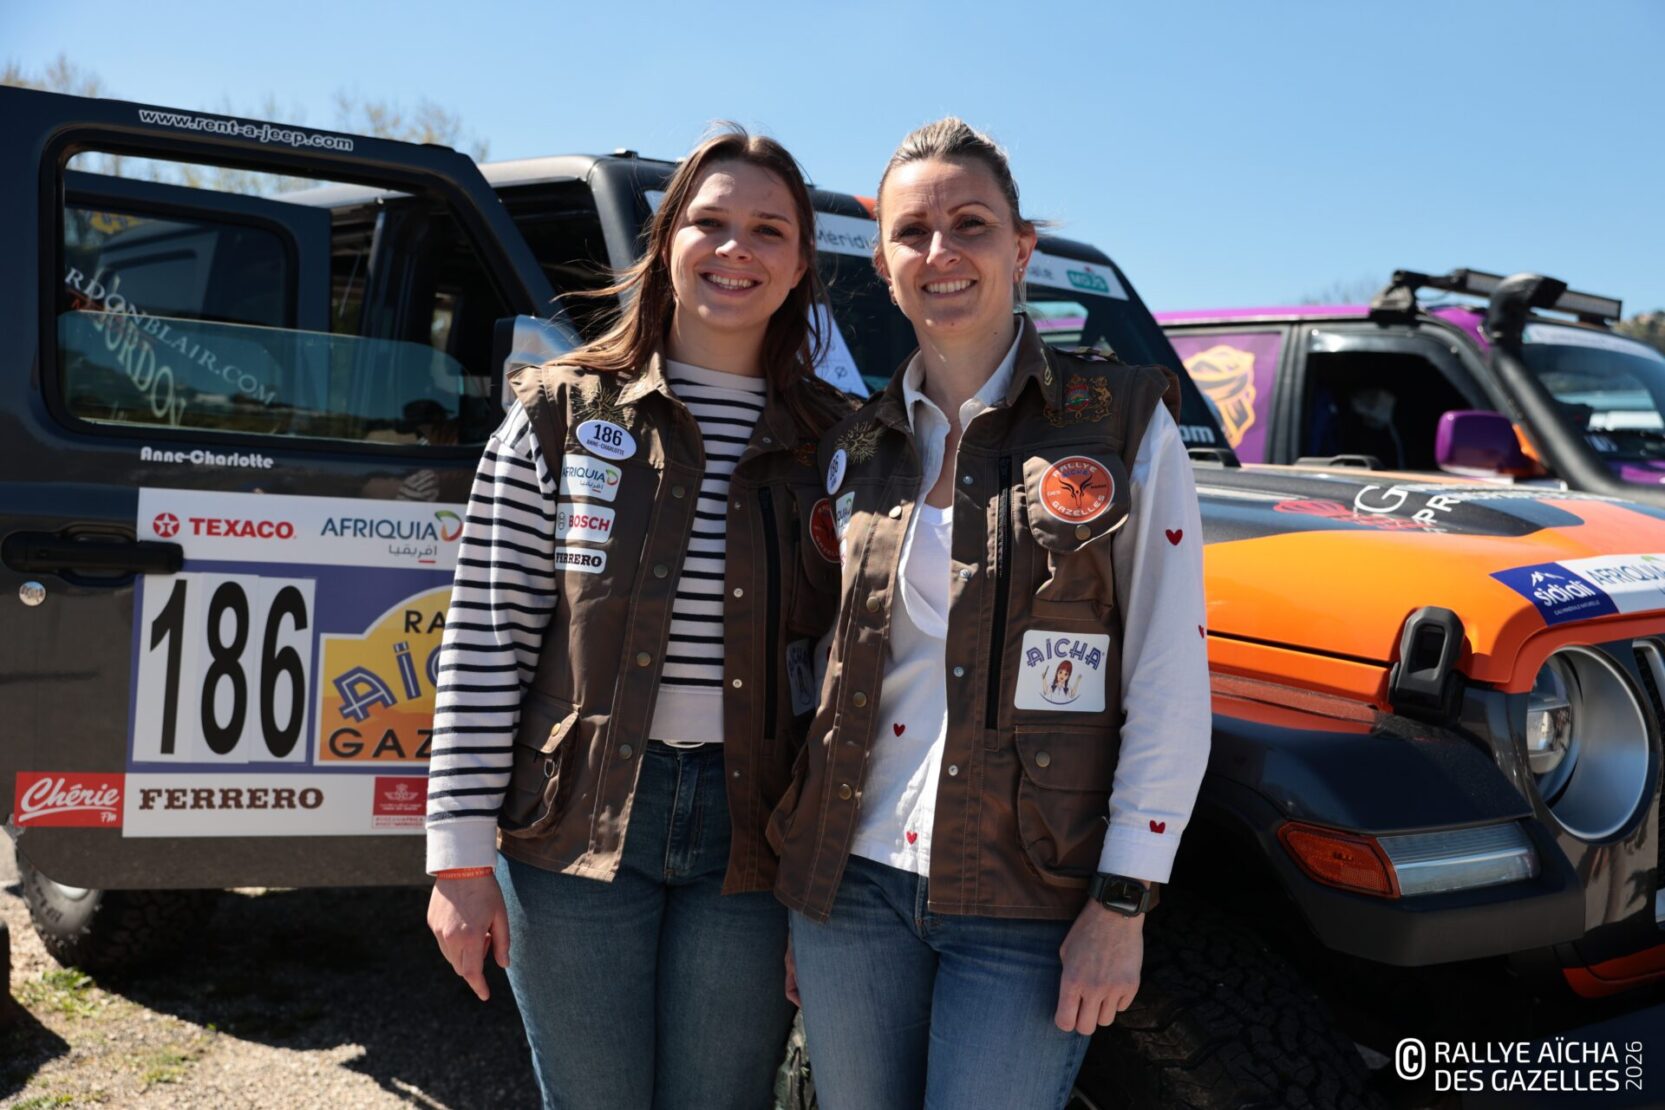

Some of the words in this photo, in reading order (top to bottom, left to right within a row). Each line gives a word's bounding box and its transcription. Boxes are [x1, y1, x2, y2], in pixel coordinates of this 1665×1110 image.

[138, 109, 354, 151] www.rent-a-jeep.com
[593, 424, 623, 446] 186
[140, 446, 274, 469] Anne-Charlotte
[1052, 495, 1105, 517] GAZELLES
[189, 517, 295, 540] TEXACO
[320, 517, 439, 541] AFRIQUIA
[568, 514, 610, 532] BOSCH
[556, 551, 603, 568] FERRERO
[1026, 638, 1102, 671] AICHA
[150, 578, 308, 758] 186
[20, 777, 120, 812] Chérie
[139, 787, 324, 810] FERRERO
